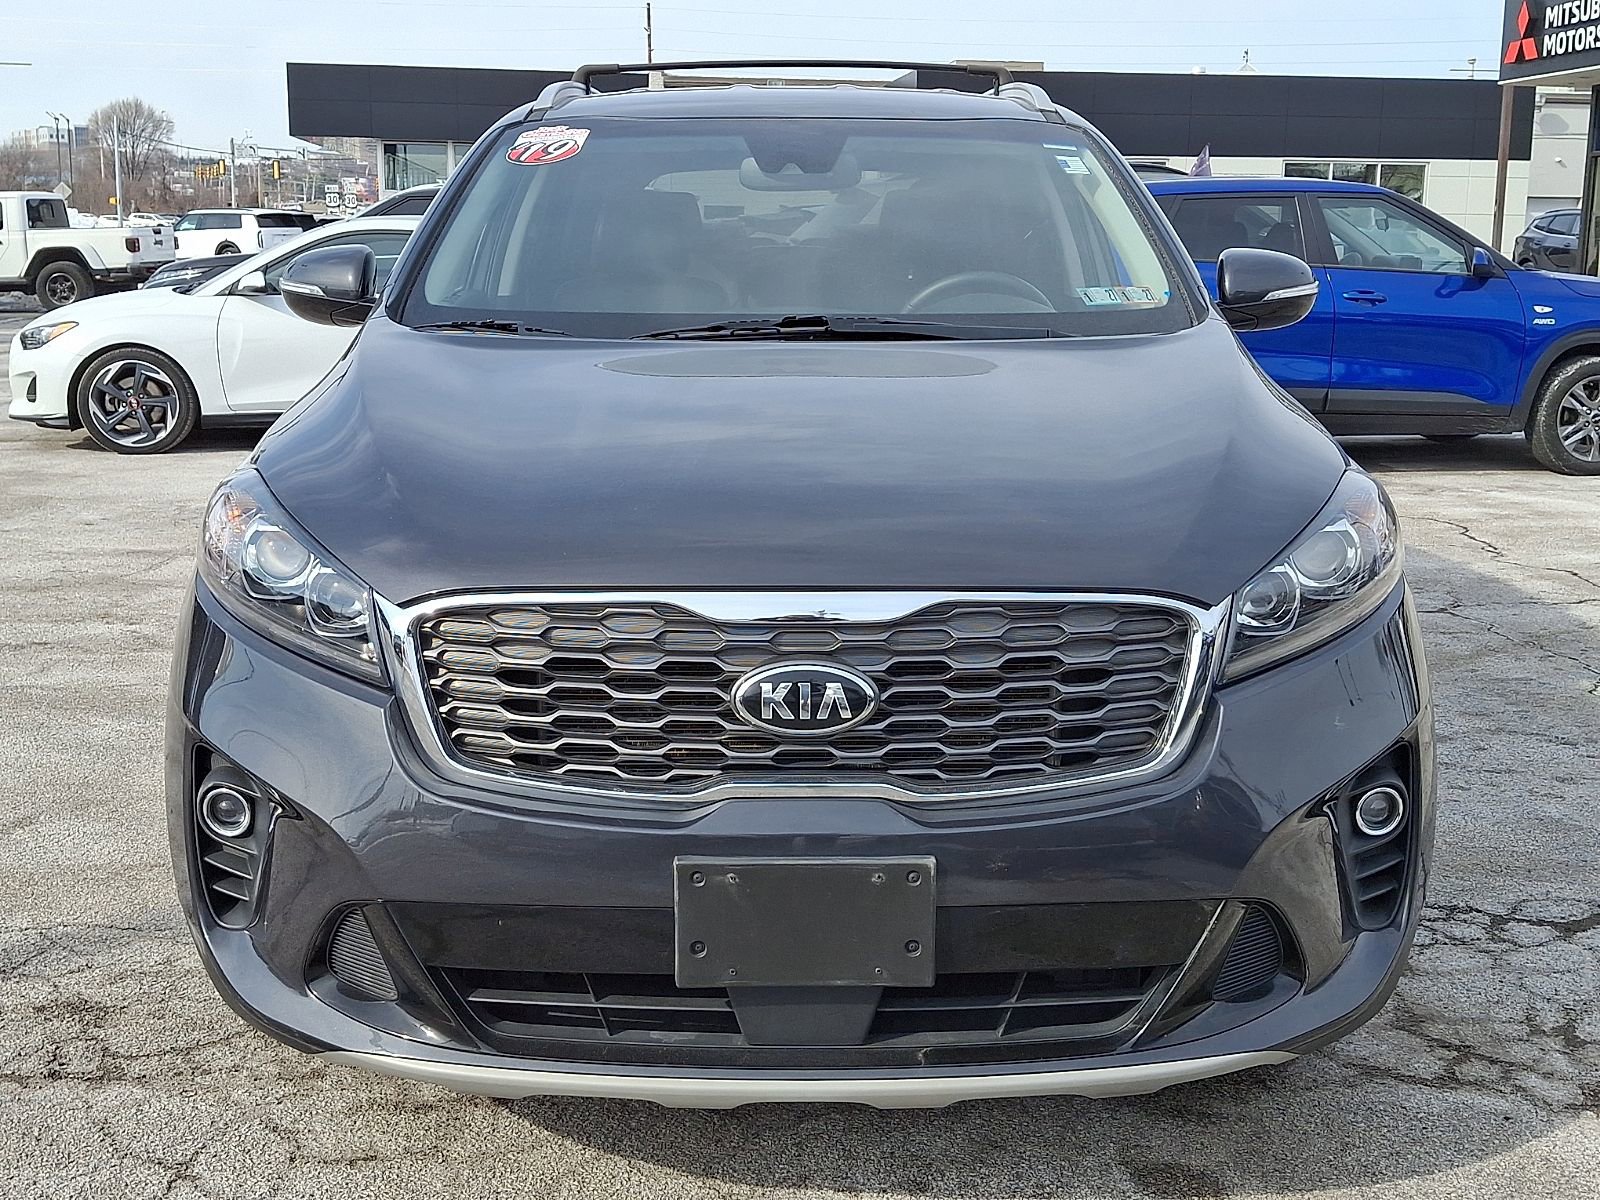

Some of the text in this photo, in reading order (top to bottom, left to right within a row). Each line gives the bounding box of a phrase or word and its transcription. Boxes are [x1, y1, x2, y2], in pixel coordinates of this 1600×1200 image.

[1544, 0, 1600, 29] MITSUB
[327, 195, 338, 204] 30
[346, 196, 356, 205] 30
[760, 682, 852, 719] KIA
